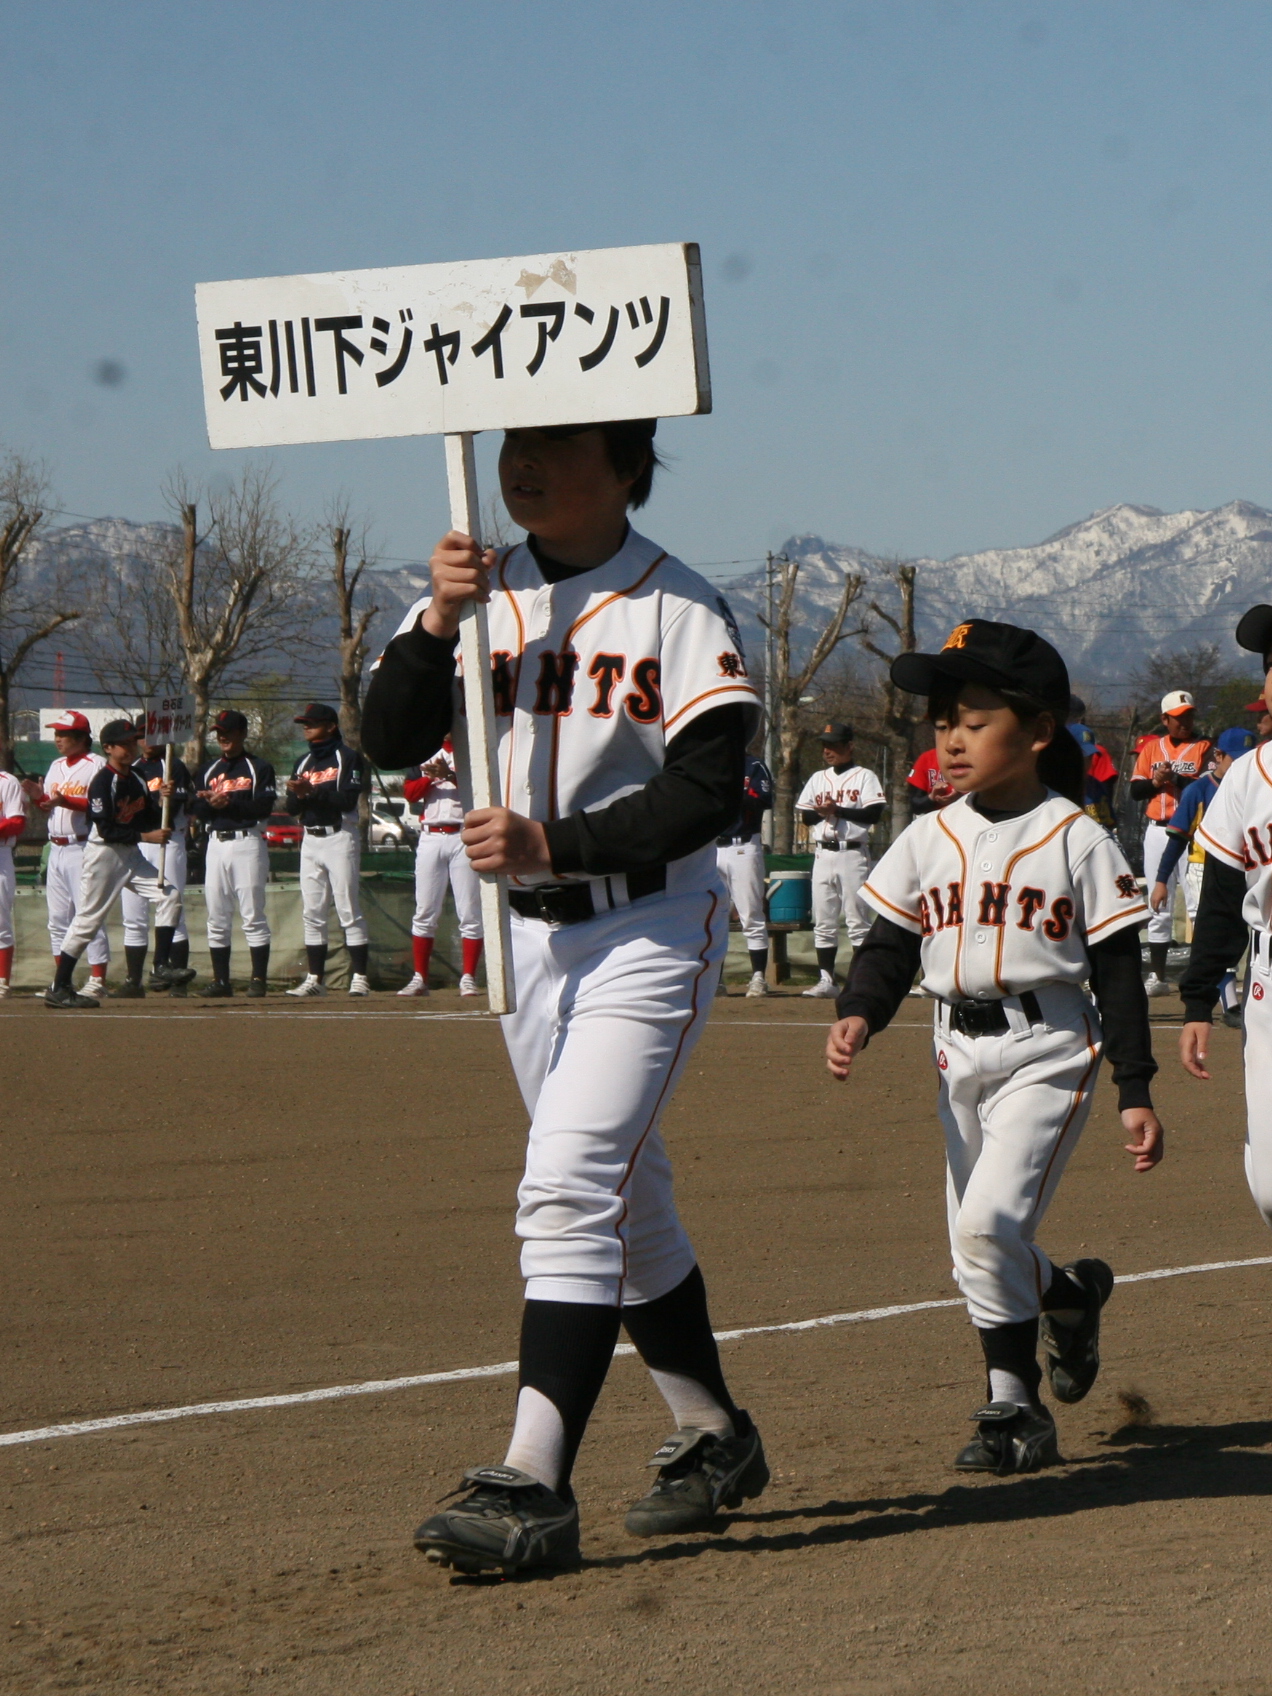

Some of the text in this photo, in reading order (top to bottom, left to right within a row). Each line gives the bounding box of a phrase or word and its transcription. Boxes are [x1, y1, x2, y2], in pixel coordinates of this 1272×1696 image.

[214, 295, 671, 402] 東川下ジャイアンツ
[456, 649, 664, 725] ANTS
